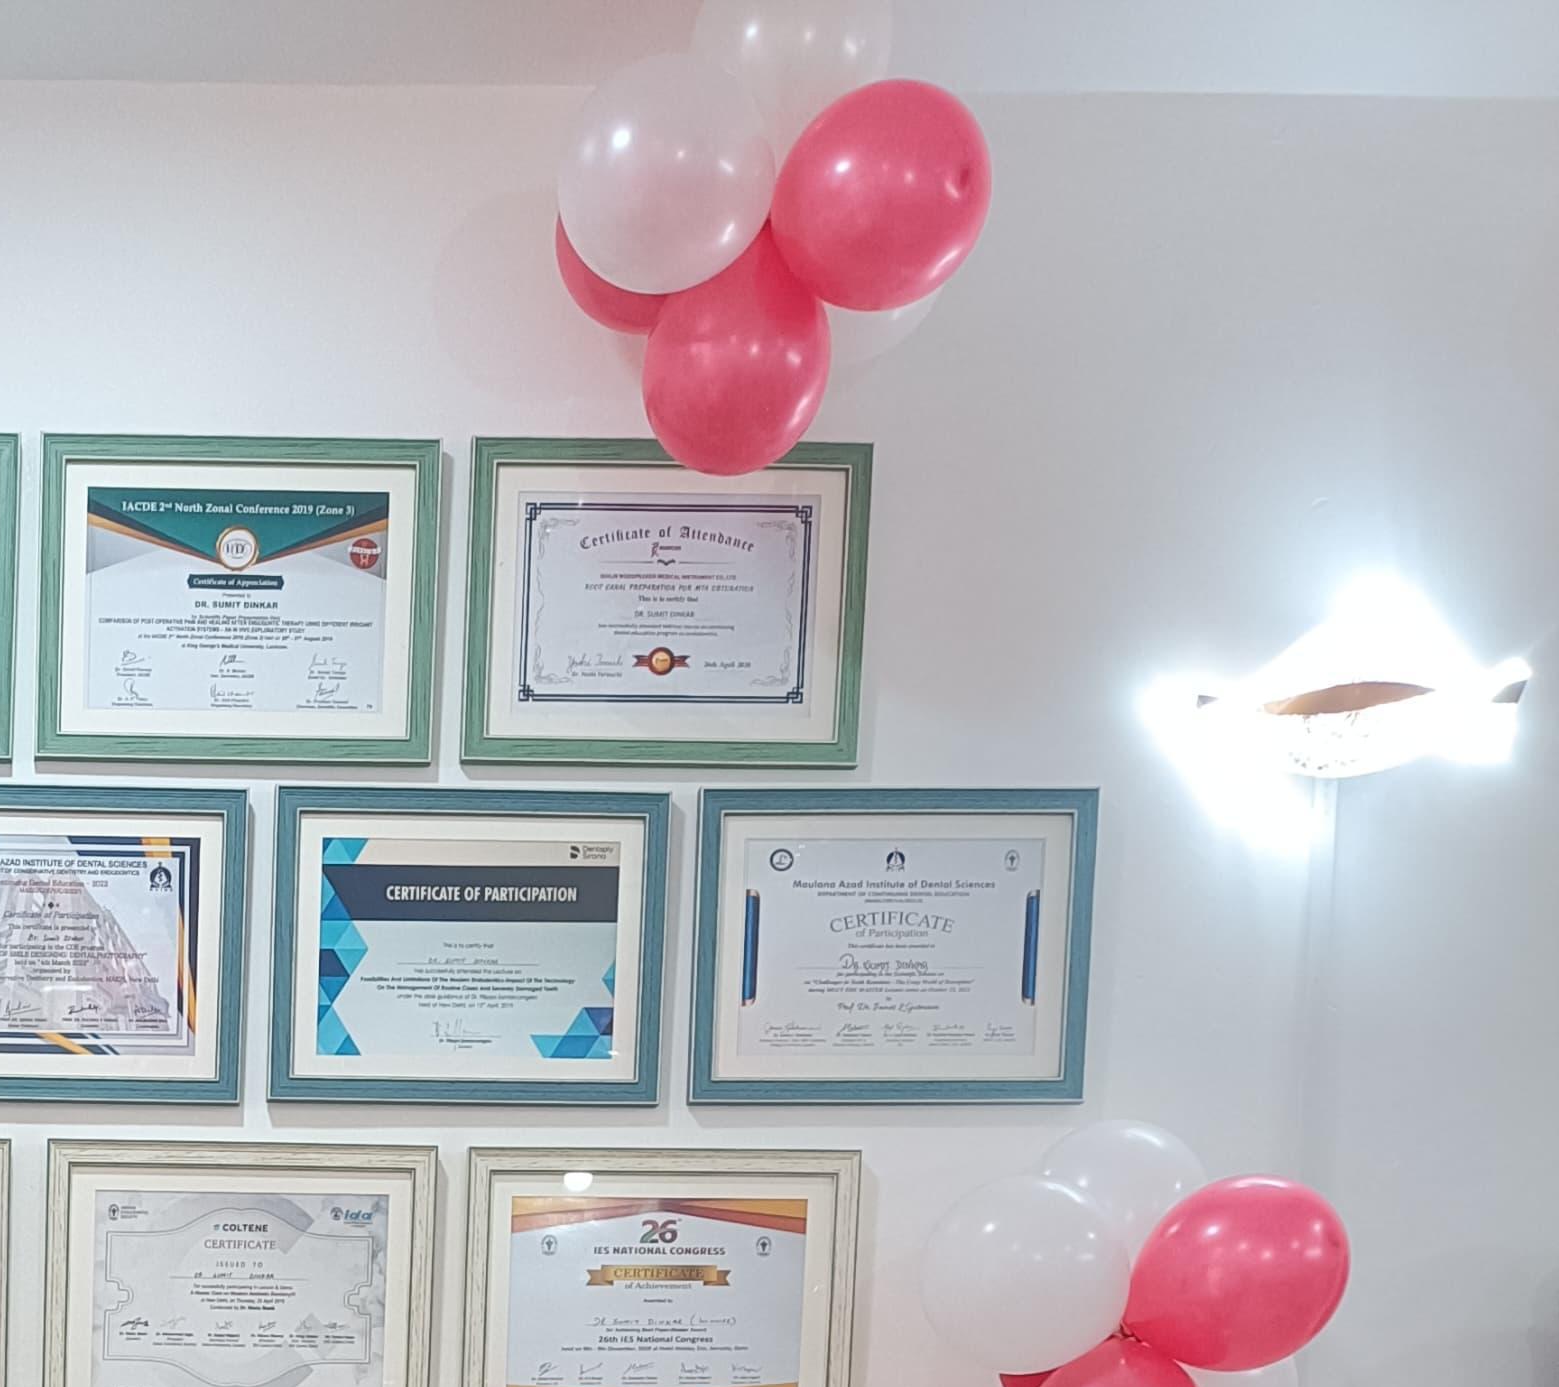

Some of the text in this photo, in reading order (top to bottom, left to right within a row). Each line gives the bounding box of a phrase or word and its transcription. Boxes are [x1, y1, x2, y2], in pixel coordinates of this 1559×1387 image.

[122, 501, 157, 513] IACDE
[174, 503, 203, 513] North
[205, 504, 233, 513] Zonal
[236, 504, 289, 514] Conference
[292, 505, 313, 514] 2019
[315, 505, 344, 516] (Zone
[580, 528, 651, 550] Certificate
[659, 526, 671, 538] of
[680, 526, 755, 552] Attendance
[195, 601, 278, 609] DR. SUMIT DINKAR
[23, 859, 63, 867] INSTITUTE
[77, 860, 107, 868] DENTAL
[109, 861, 147, 869] SCIENCES
[793, 880, 995, 889] Maulana Azad Institute of Dental Sciences
[386, 886, 577, 902] CERTIFICATE OF PARTICIPATION
[830, 911, 955, 934] CERTIFICATE
[856, 928, 929, 940] of Participation
[222, 1223, 268, 1232] COLTENE
[204, 1239, 276, 1250] CERTIFICATE
[594, 1246, 726, 1256] IES NATIONAL CONGRESS
[613, 1268, 705, 1279] CERTIFICATE
[625, 1281, 692, 1290] of Achievement
[598, 1335, 618, 1343] 26th
[636, 1336, 673, 1344] National
[675, 1336, 713, 1345] Congress
